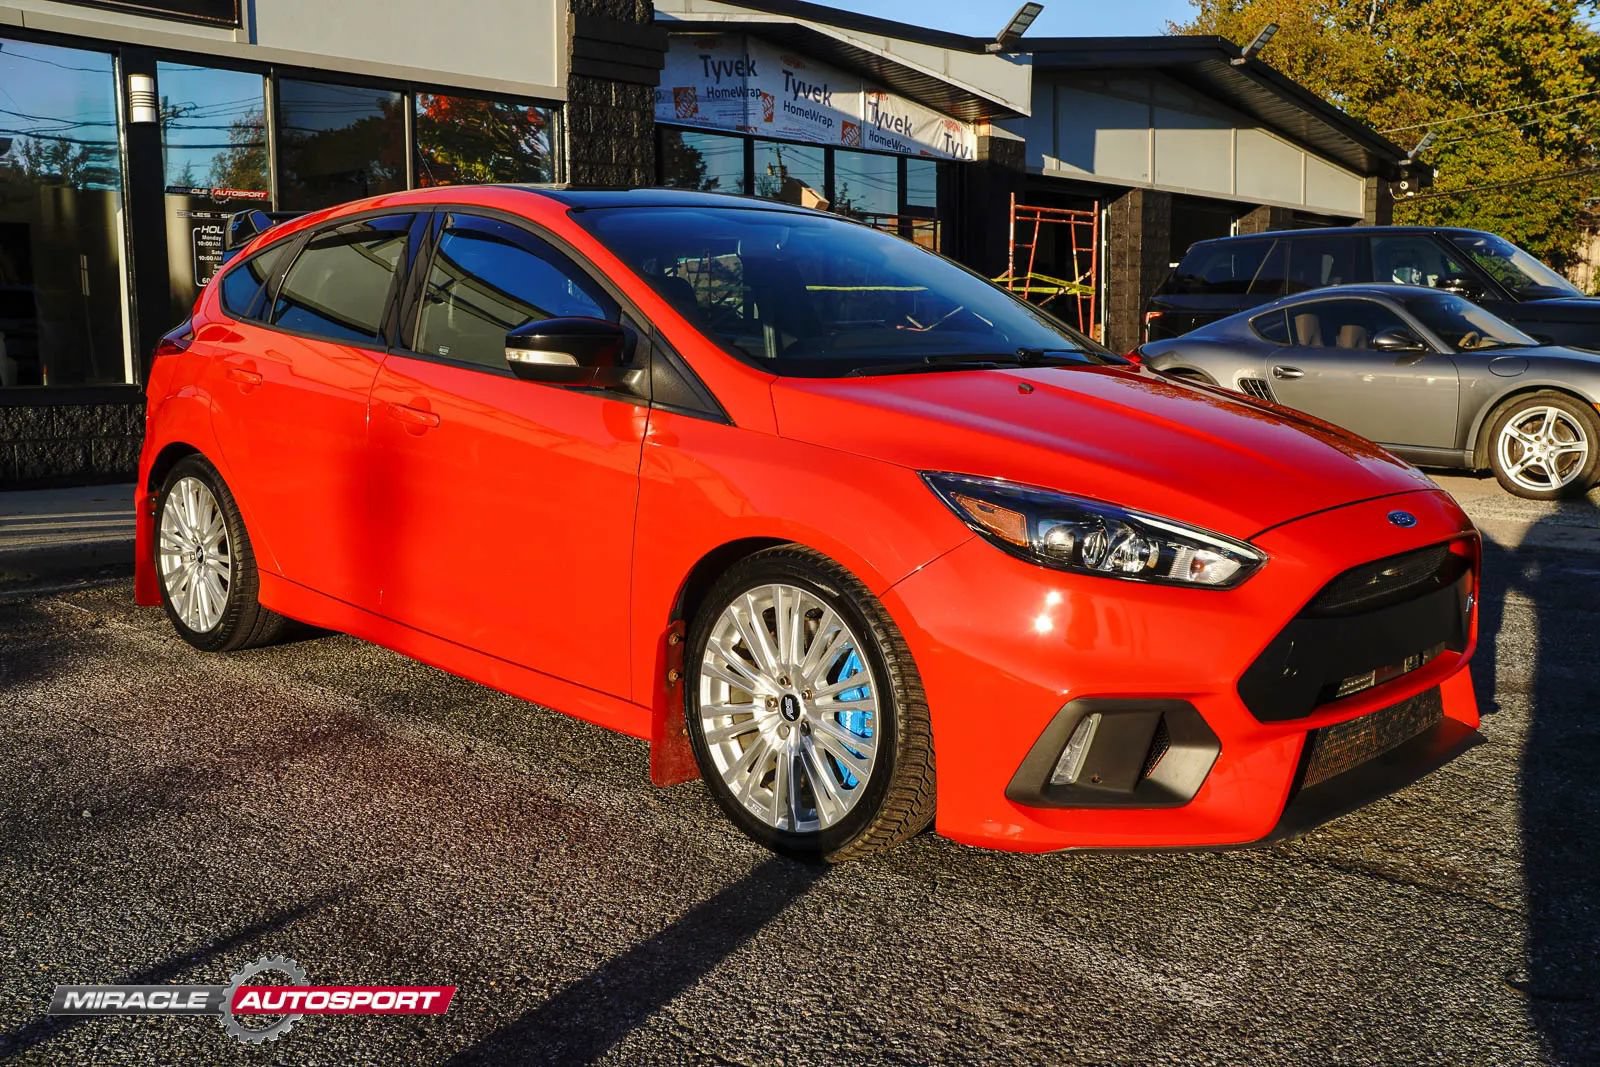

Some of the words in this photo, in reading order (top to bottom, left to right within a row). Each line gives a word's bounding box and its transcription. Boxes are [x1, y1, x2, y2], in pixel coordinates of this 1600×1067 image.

[699, 53, 758, 84] Tyvek
[706, 86, 761, 100] HomeWrap
[782, 69, 832, 107] Tyvek
[868, 100, 912, 137] Tyvek
[215, 190, 266, 198] AUTOSPORT
